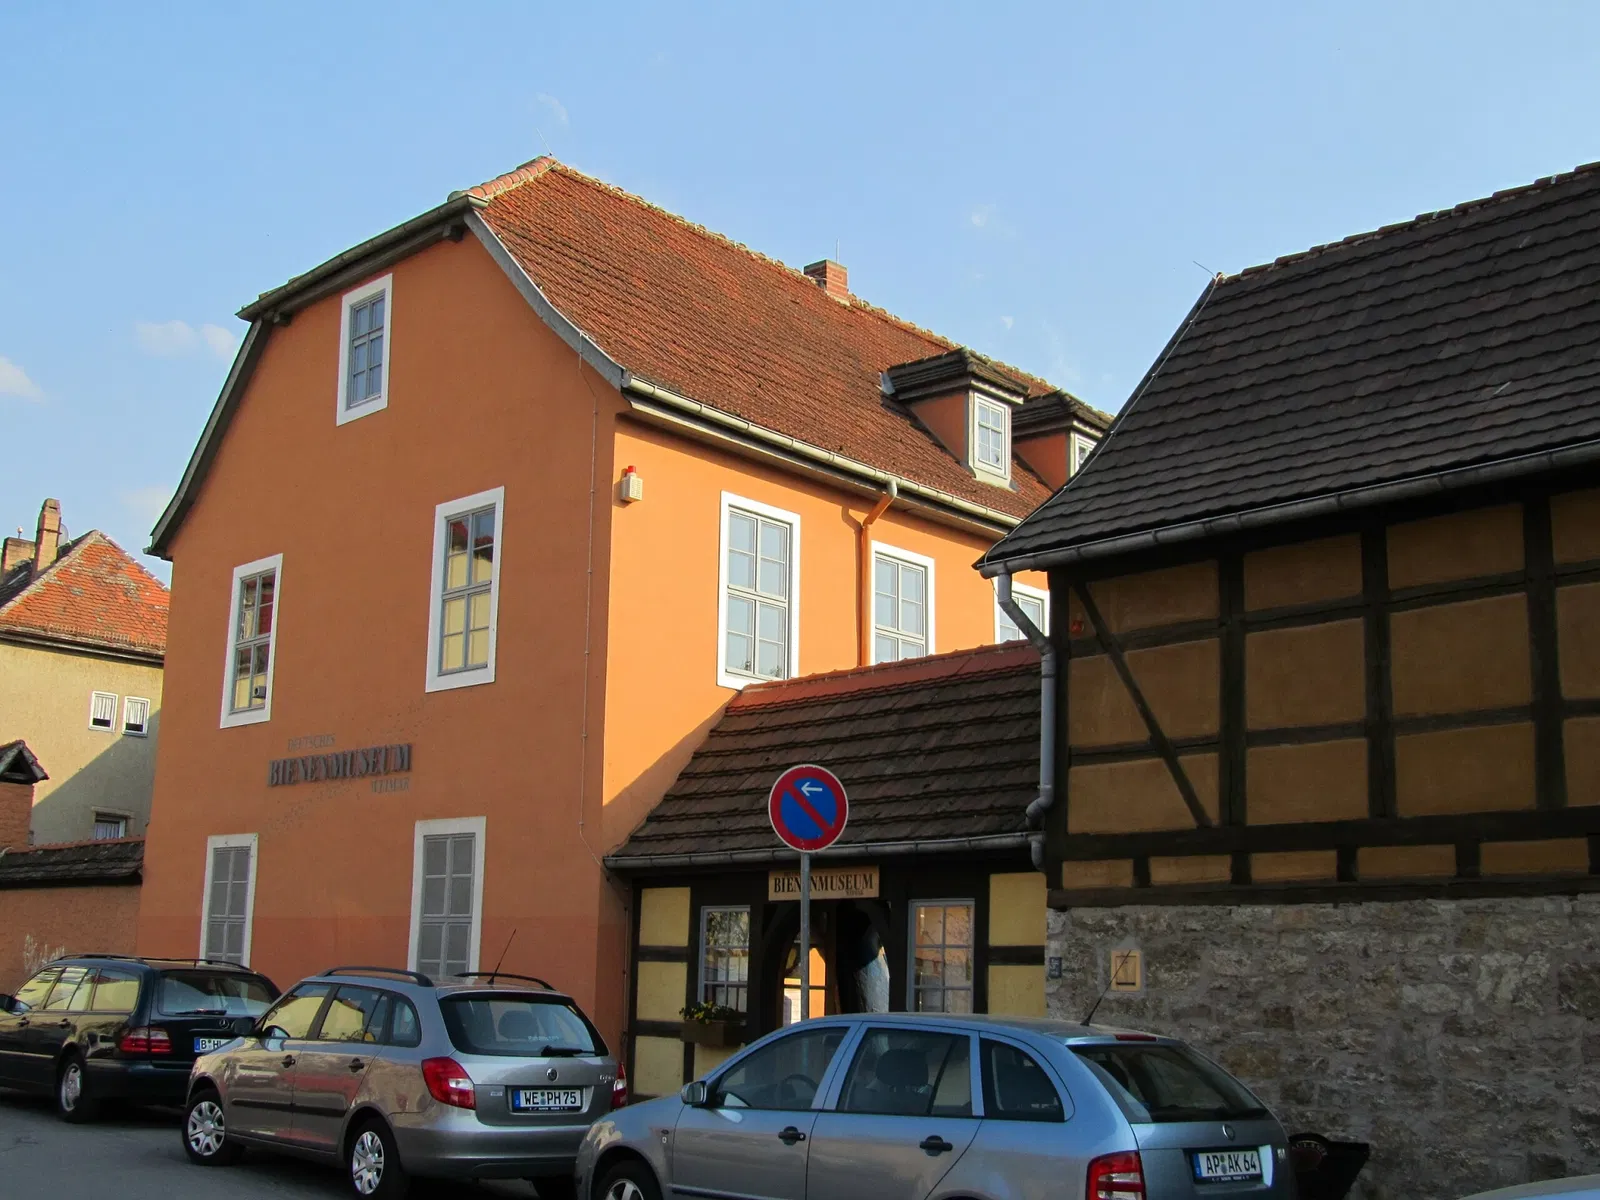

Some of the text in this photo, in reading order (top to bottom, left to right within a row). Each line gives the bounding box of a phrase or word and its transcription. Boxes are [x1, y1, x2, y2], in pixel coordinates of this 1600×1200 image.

[267, 743, 412, 787] BIENENMUSEUM
[774, 873, 874, 894] BIENNMUSEUM
[201, 1039, 207, 1050] B
[524, 1090, 577, 1106] WE PH 75
[1206, 1155, 1220, 1175] AP
[1227, 1154, 1242, 1173] AK
[1243, 1153, 1257, 1172] 64
